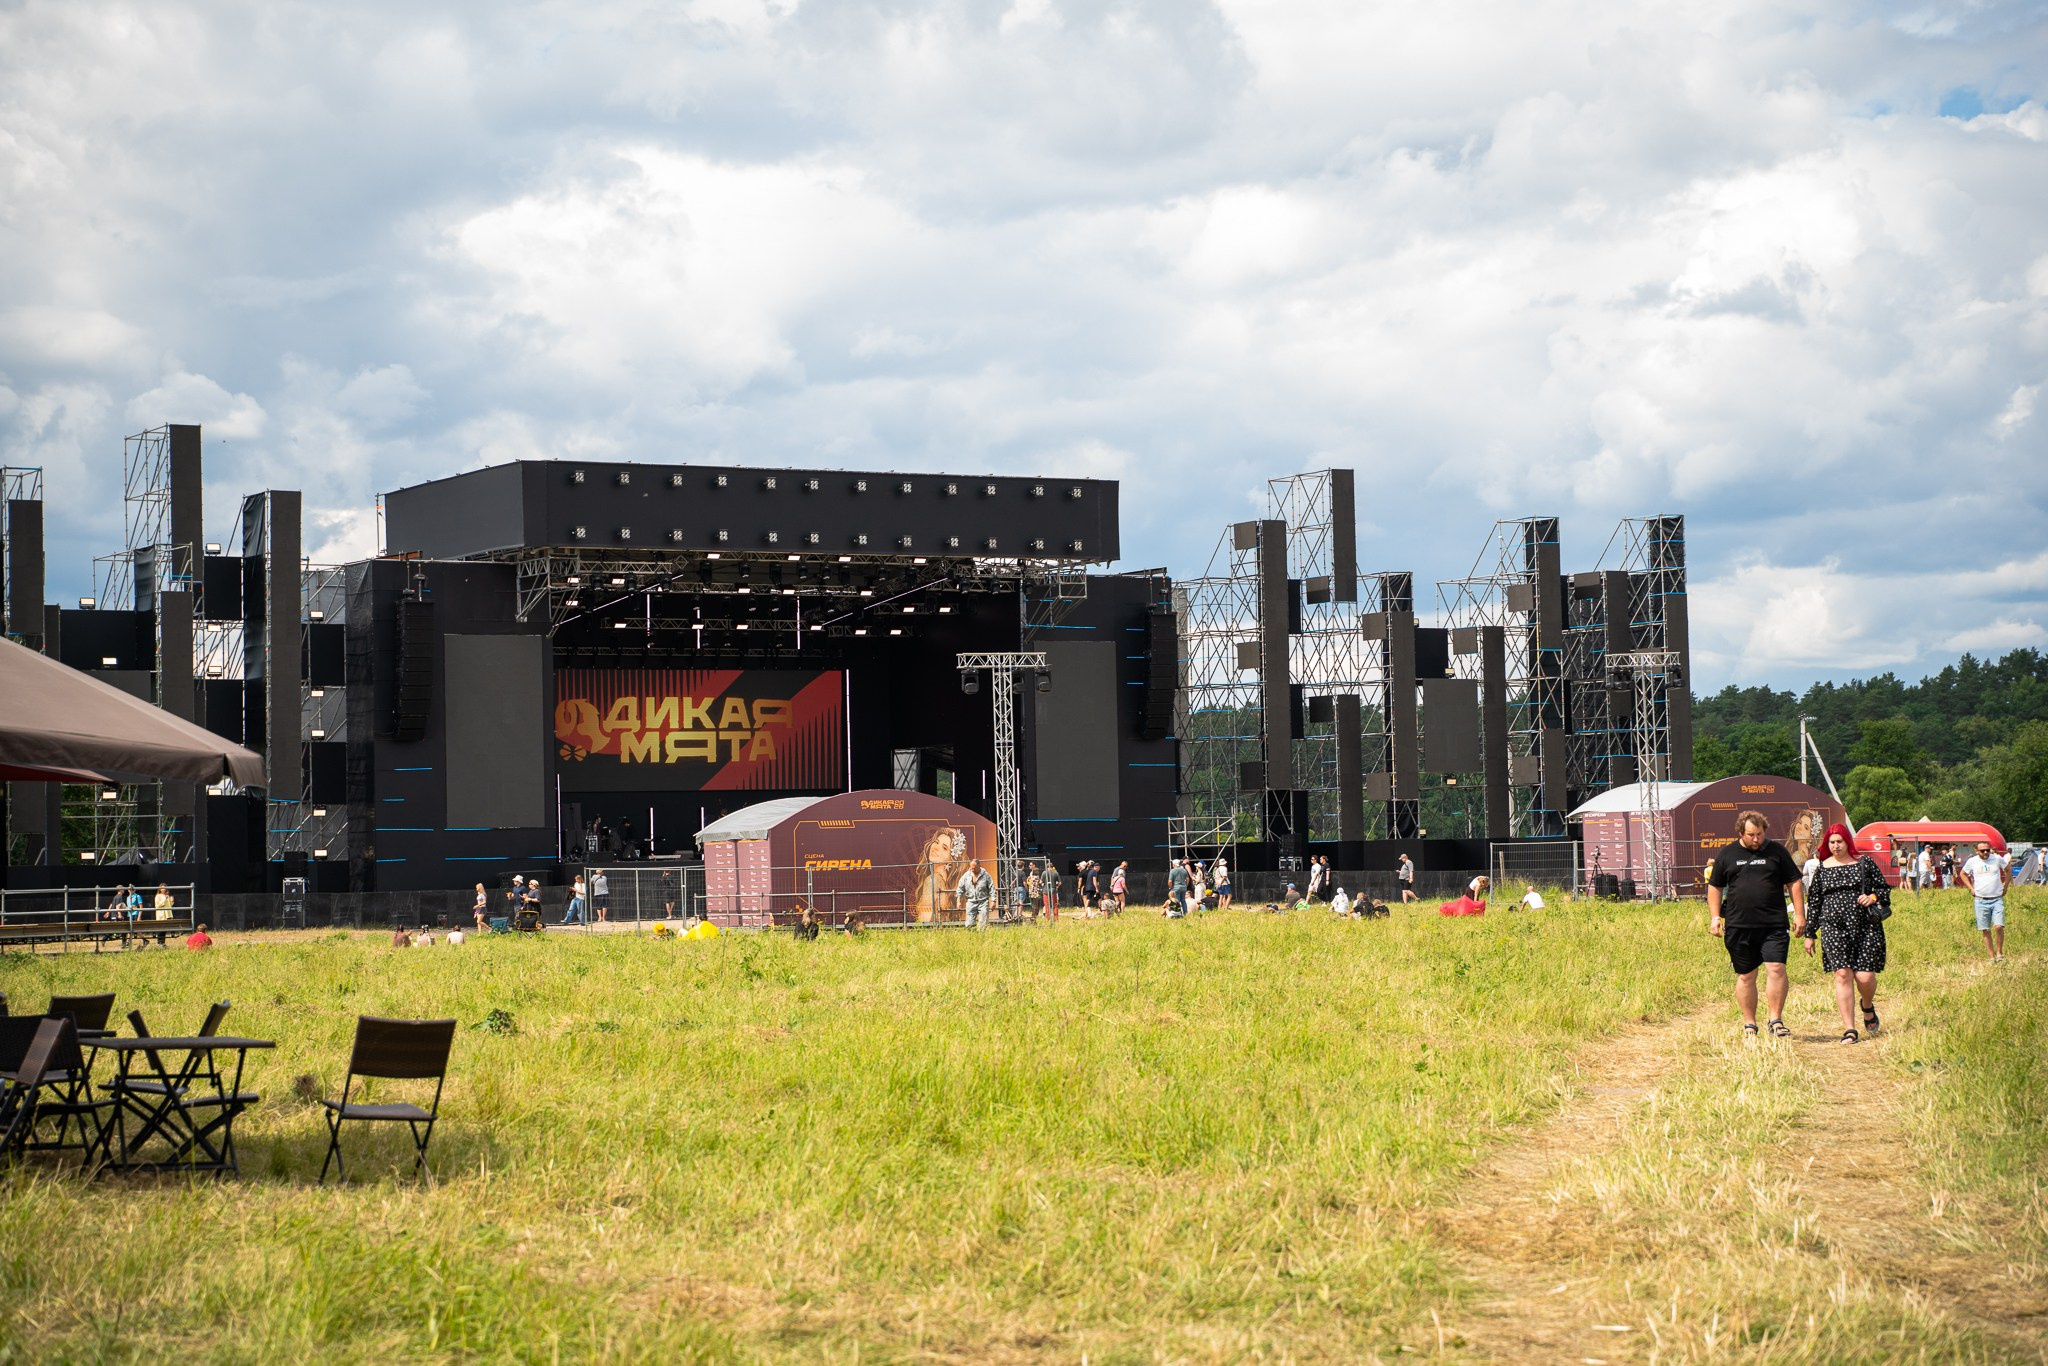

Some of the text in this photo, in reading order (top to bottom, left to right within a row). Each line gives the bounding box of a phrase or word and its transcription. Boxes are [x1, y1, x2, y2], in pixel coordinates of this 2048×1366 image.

[603, 696, 793, 733] ДИКАЯ
[620, 731, 777, 763] МЯТА
[804, 859, 872, 871] СИРЕНА
